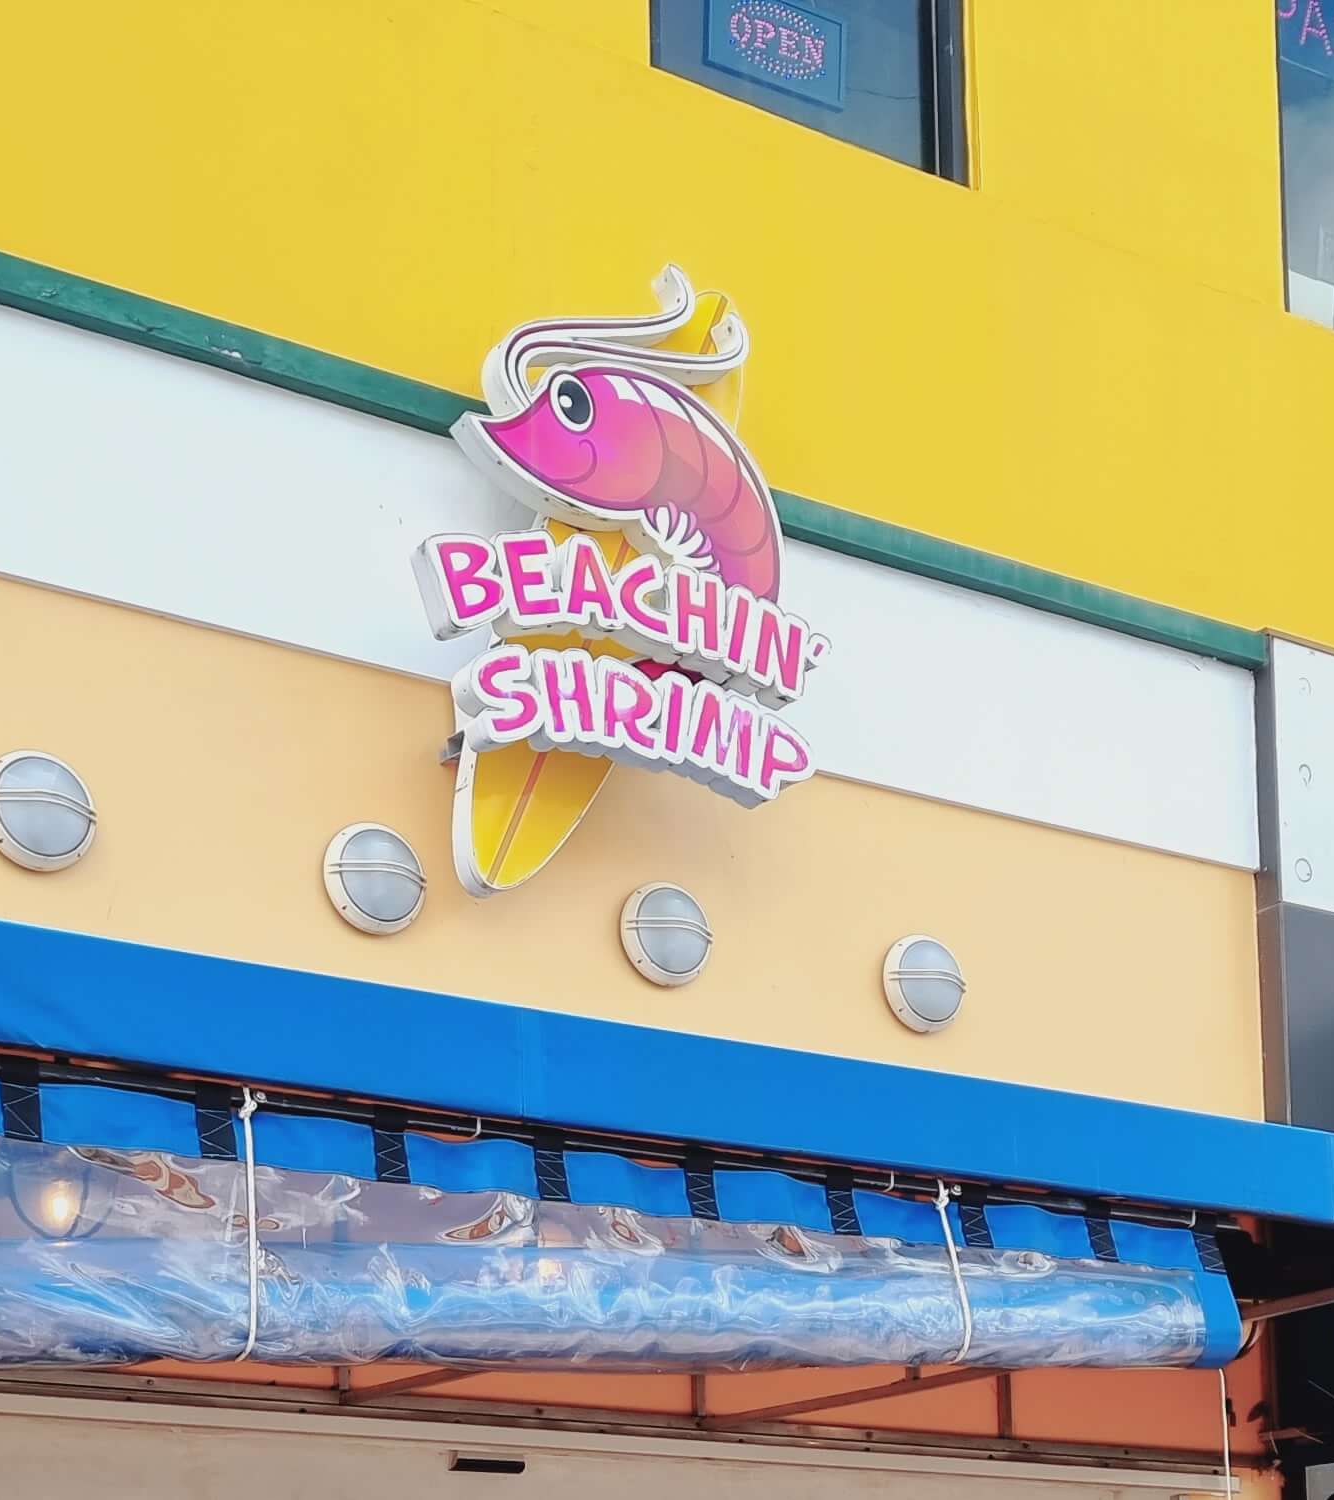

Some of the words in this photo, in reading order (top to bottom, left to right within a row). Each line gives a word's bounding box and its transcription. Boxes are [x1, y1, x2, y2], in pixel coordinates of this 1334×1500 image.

[730, 10, 824, 65] OPEN
[435, 536, 828, 692] BEACHIN'
[476, 652, 811, 791] SHRIMP
